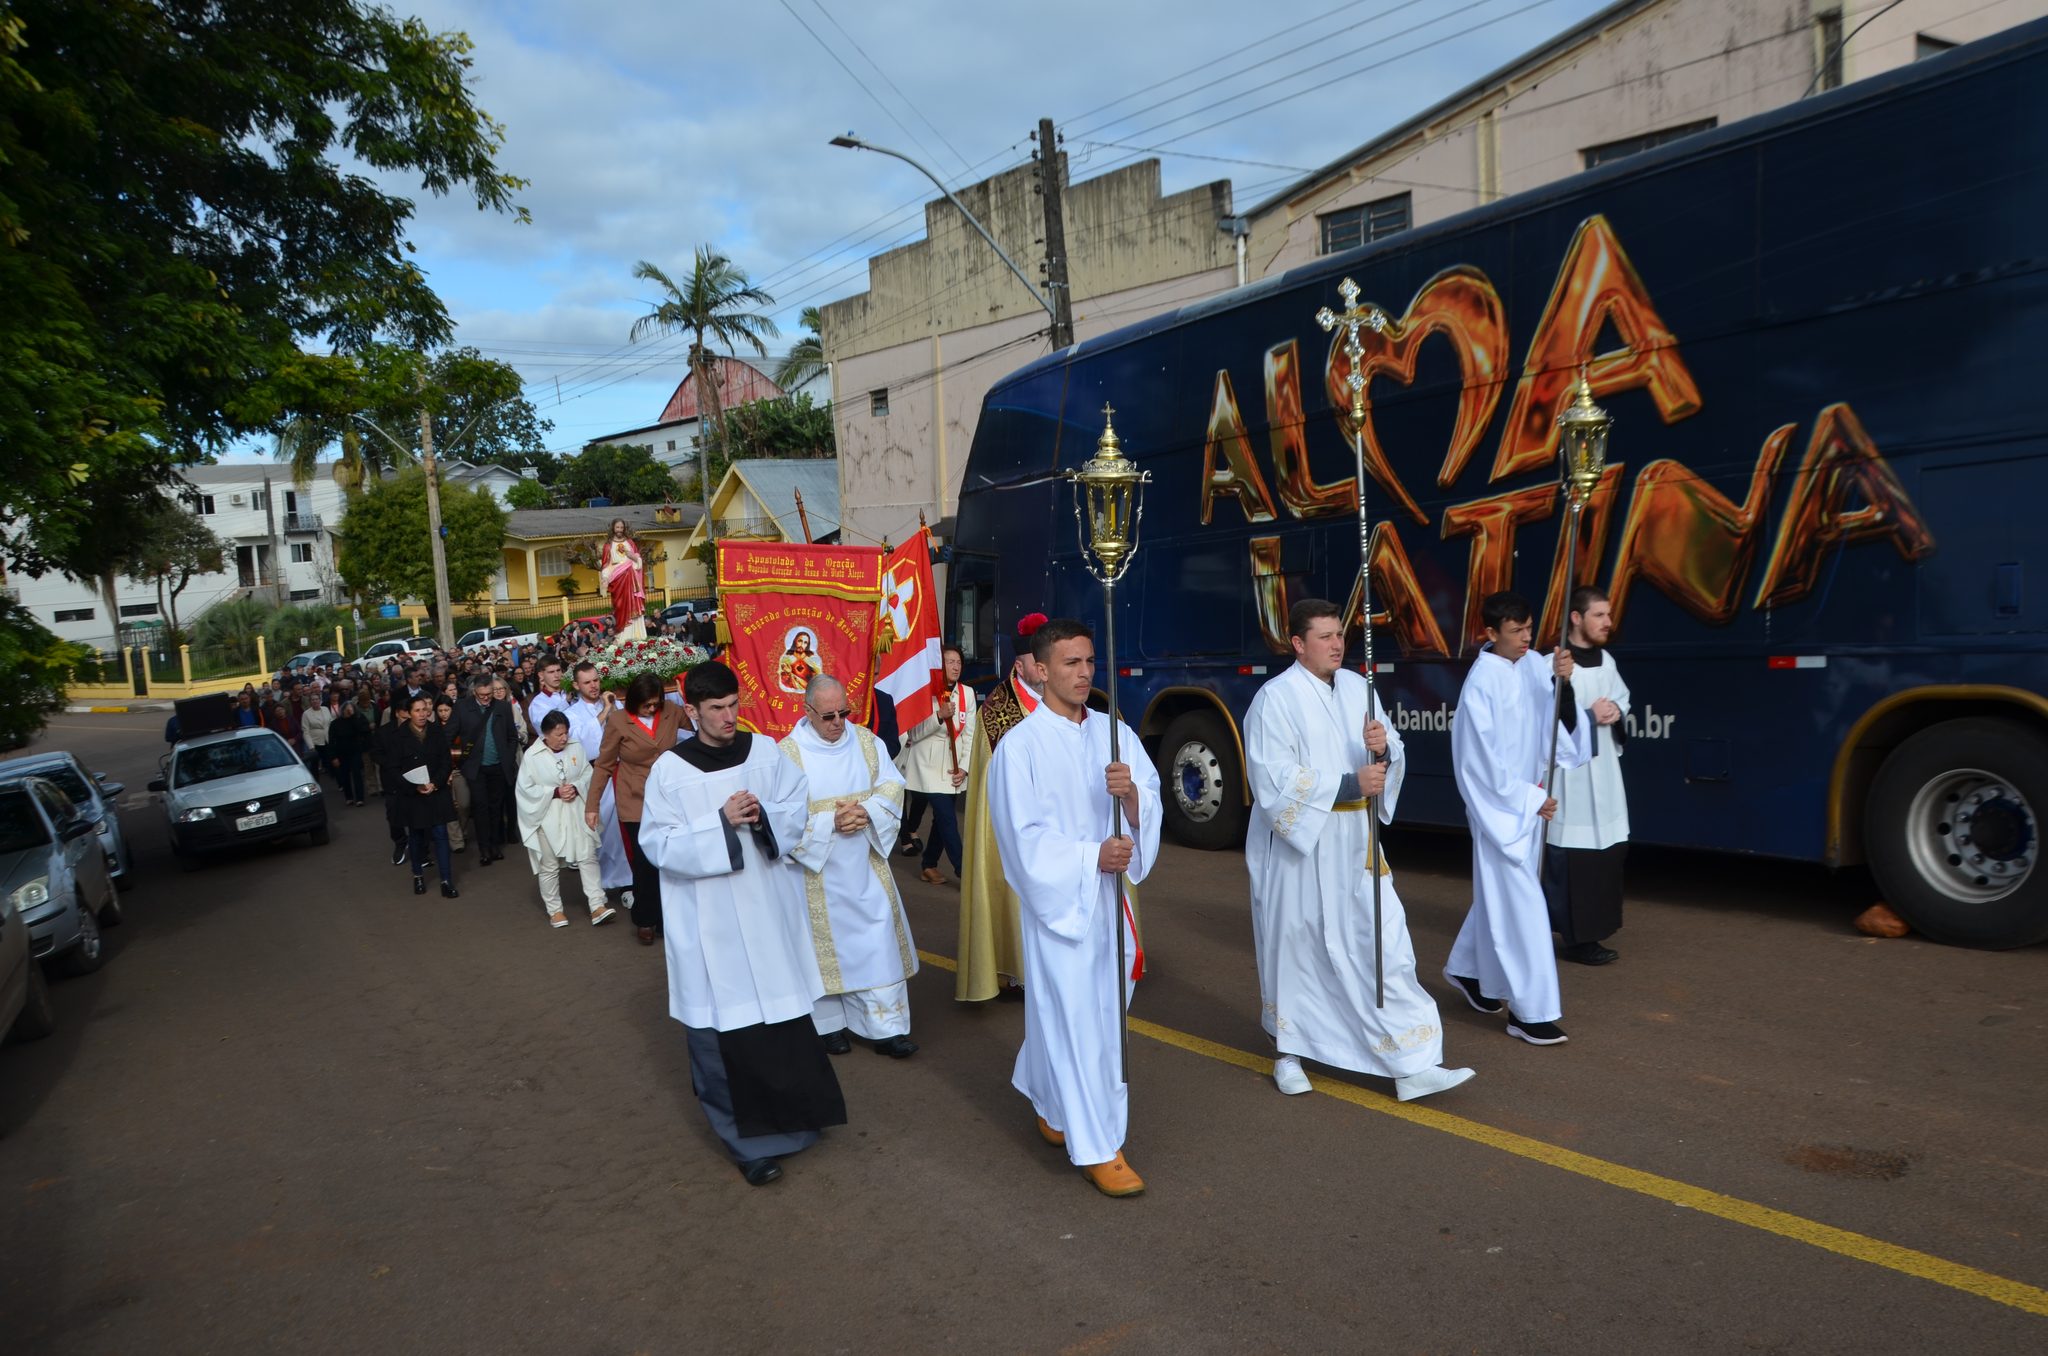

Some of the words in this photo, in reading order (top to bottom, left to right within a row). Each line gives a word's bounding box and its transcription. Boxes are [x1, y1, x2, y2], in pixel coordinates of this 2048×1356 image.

[1200, 213, 1703, 527] ALMA
[1248, 402, 1934, 658] LATINA
[747, 552, 795, 566] Apostolado
[804, 557, 814, 567] da
[825, 556, 855, 569] Oração
[743, 611, 780, 635] Sagrado
[783, 607, 822, 618] Coração
[825, 611, 835, 623] de
[836, 618, 858, 642] Jesus
[737, 660, 759, 691] Venha
